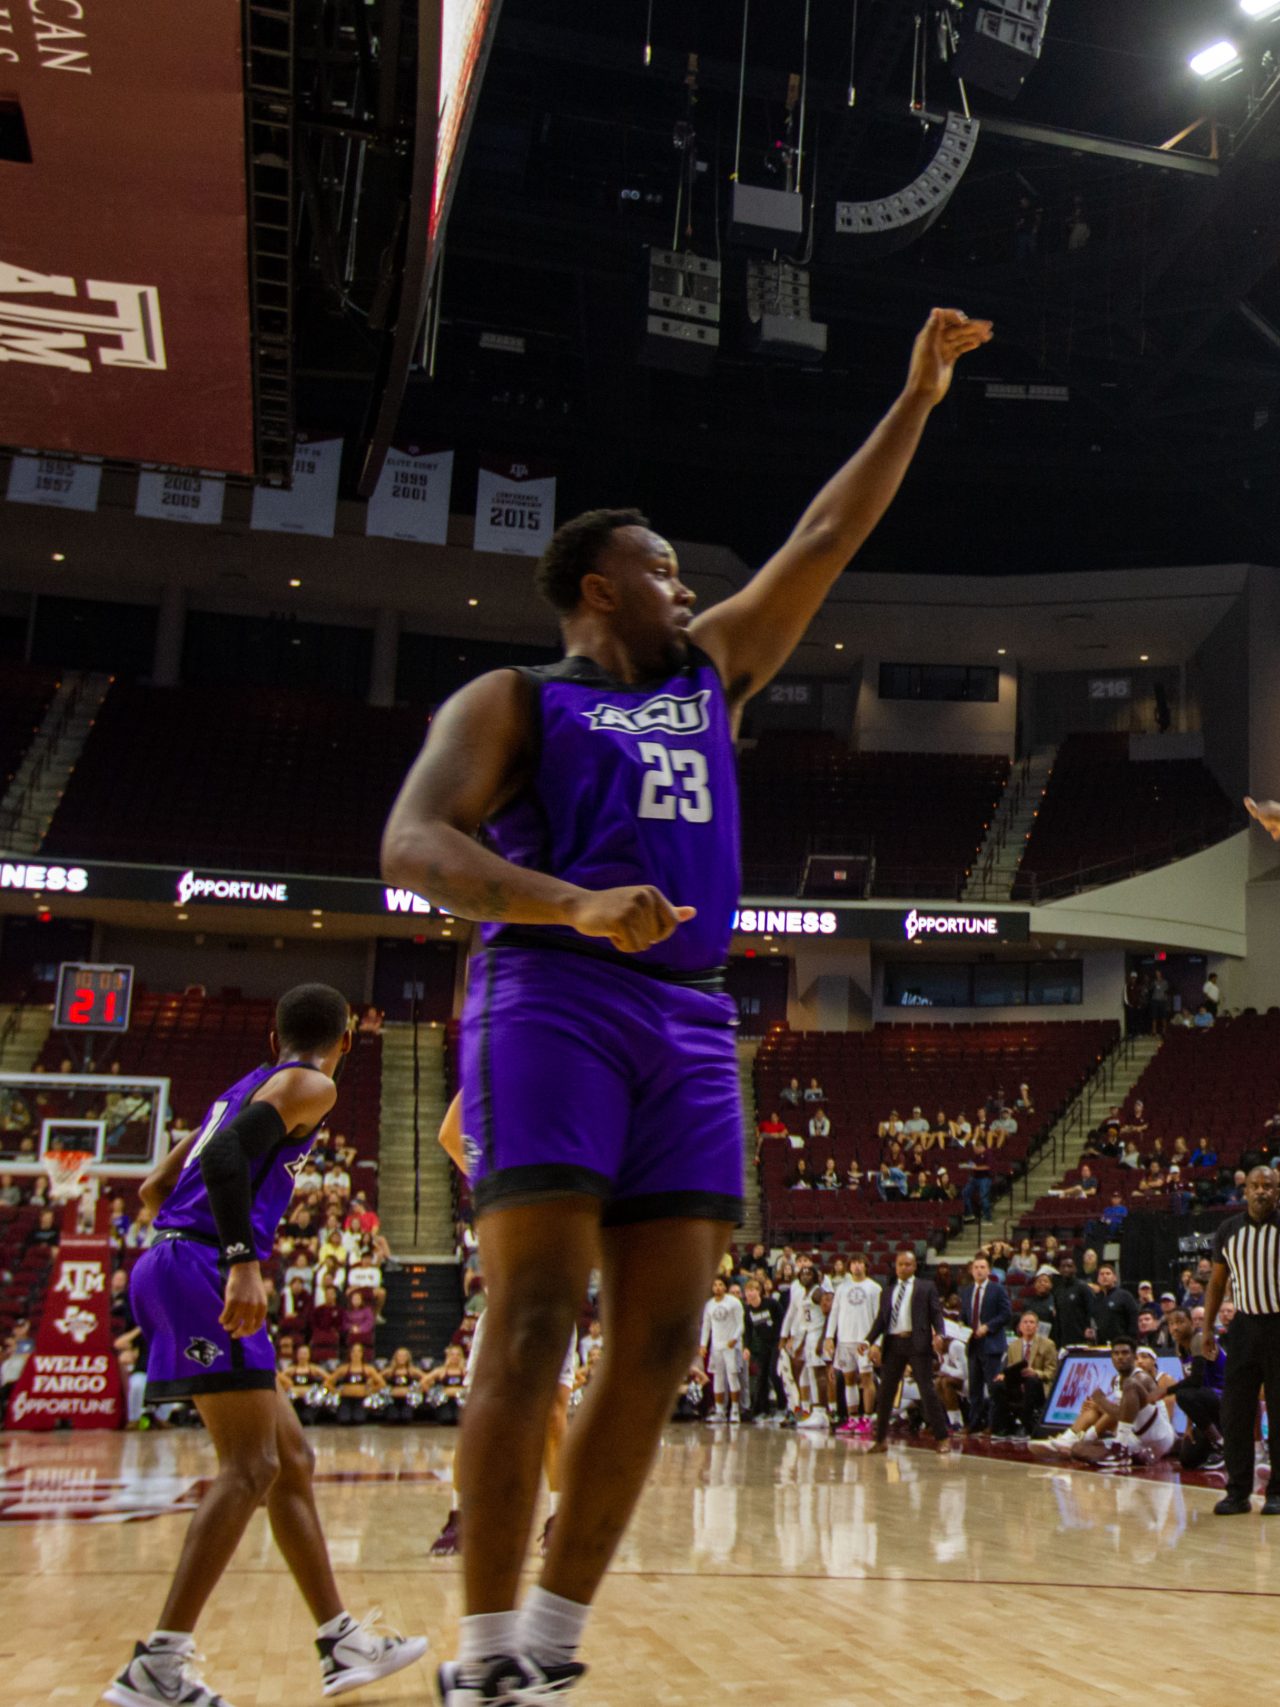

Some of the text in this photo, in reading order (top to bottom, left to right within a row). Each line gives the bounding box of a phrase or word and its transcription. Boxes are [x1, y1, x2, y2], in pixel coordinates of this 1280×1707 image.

[393, 471, 429, 487] 1999
[392, 485, 428, 502] 2001
[489, 506, 541, 531] 2015
[1091, 680, 1128, 697] 216
[592, 694, 706, 733] ACU
[636, 742, 713, 824] 23
[0, 864, 88, 892] NESS
[731, 910, 838, 934] SINESS
[68, 980, 117, 1025] 21
[33, 1355, 108, 1374] WELLS
[32, 1374, 107, 1394] FARGO
